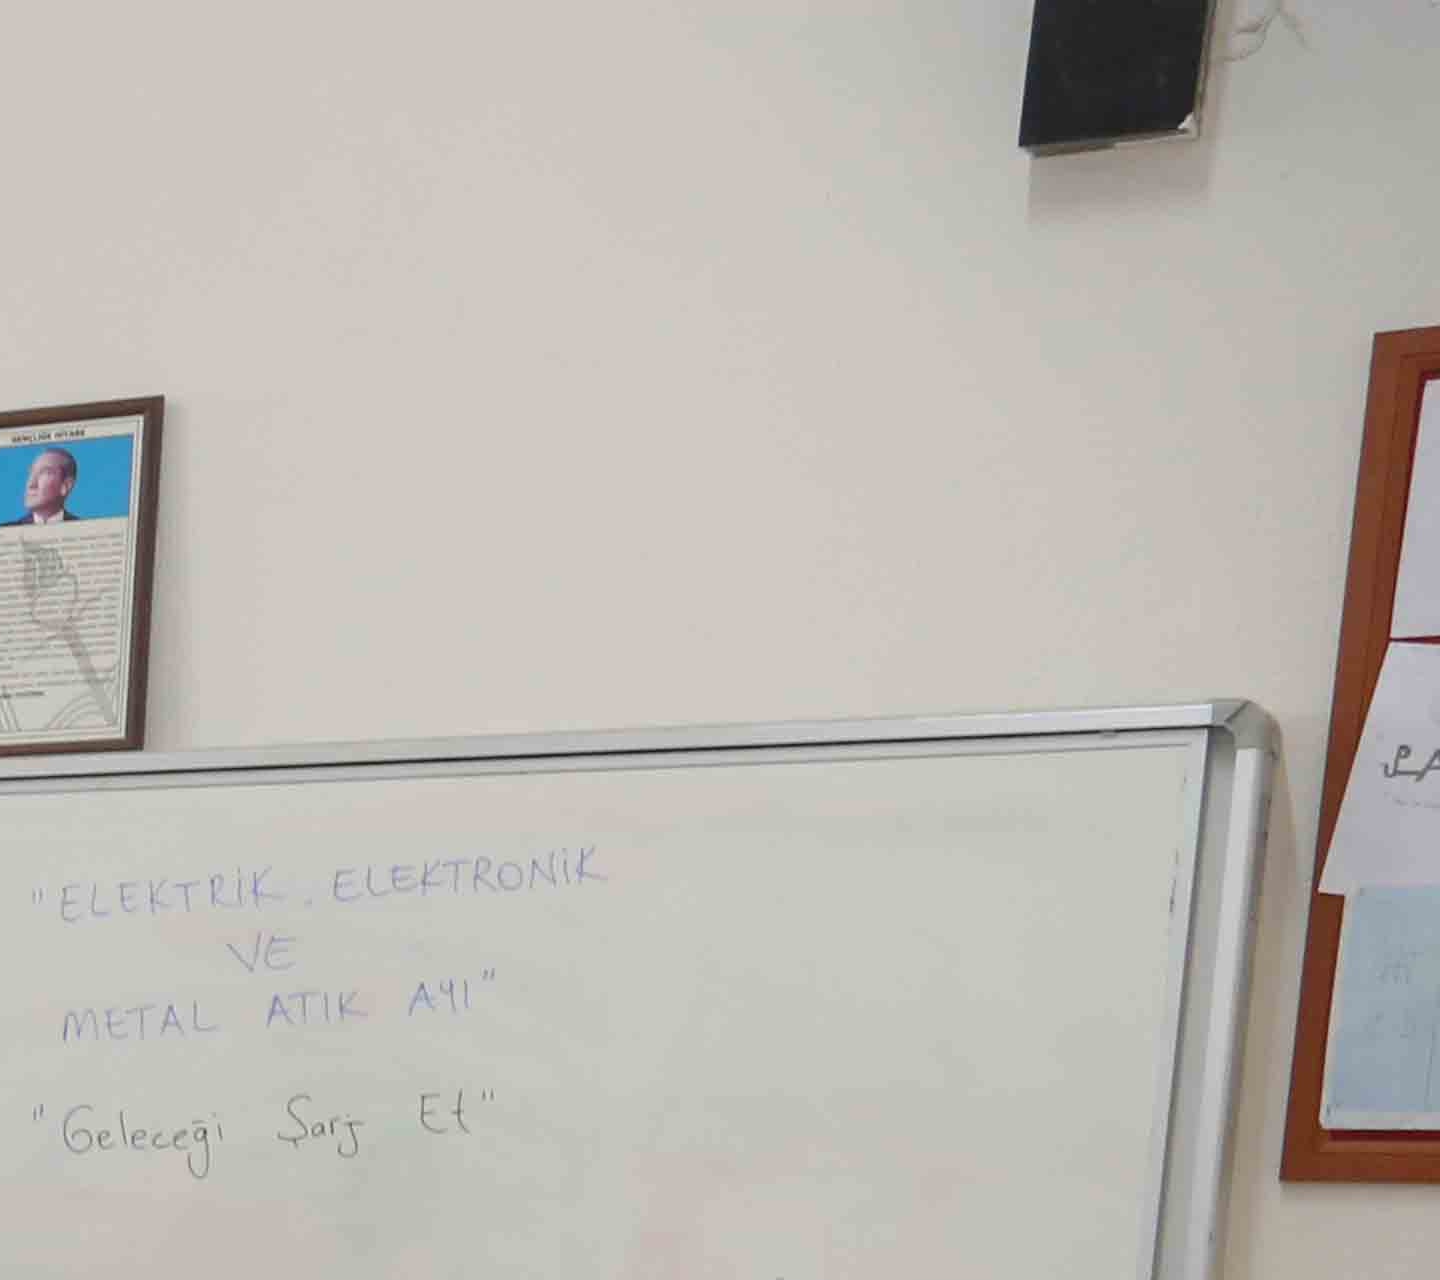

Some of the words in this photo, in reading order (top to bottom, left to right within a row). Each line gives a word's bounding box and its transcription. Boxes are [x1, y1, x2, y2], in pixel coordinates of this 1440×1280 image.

[225, 931, 298, 974] VE
[61, 1000, 220, 1044] METAL
[265, 990, 369, 1030] ATIK
